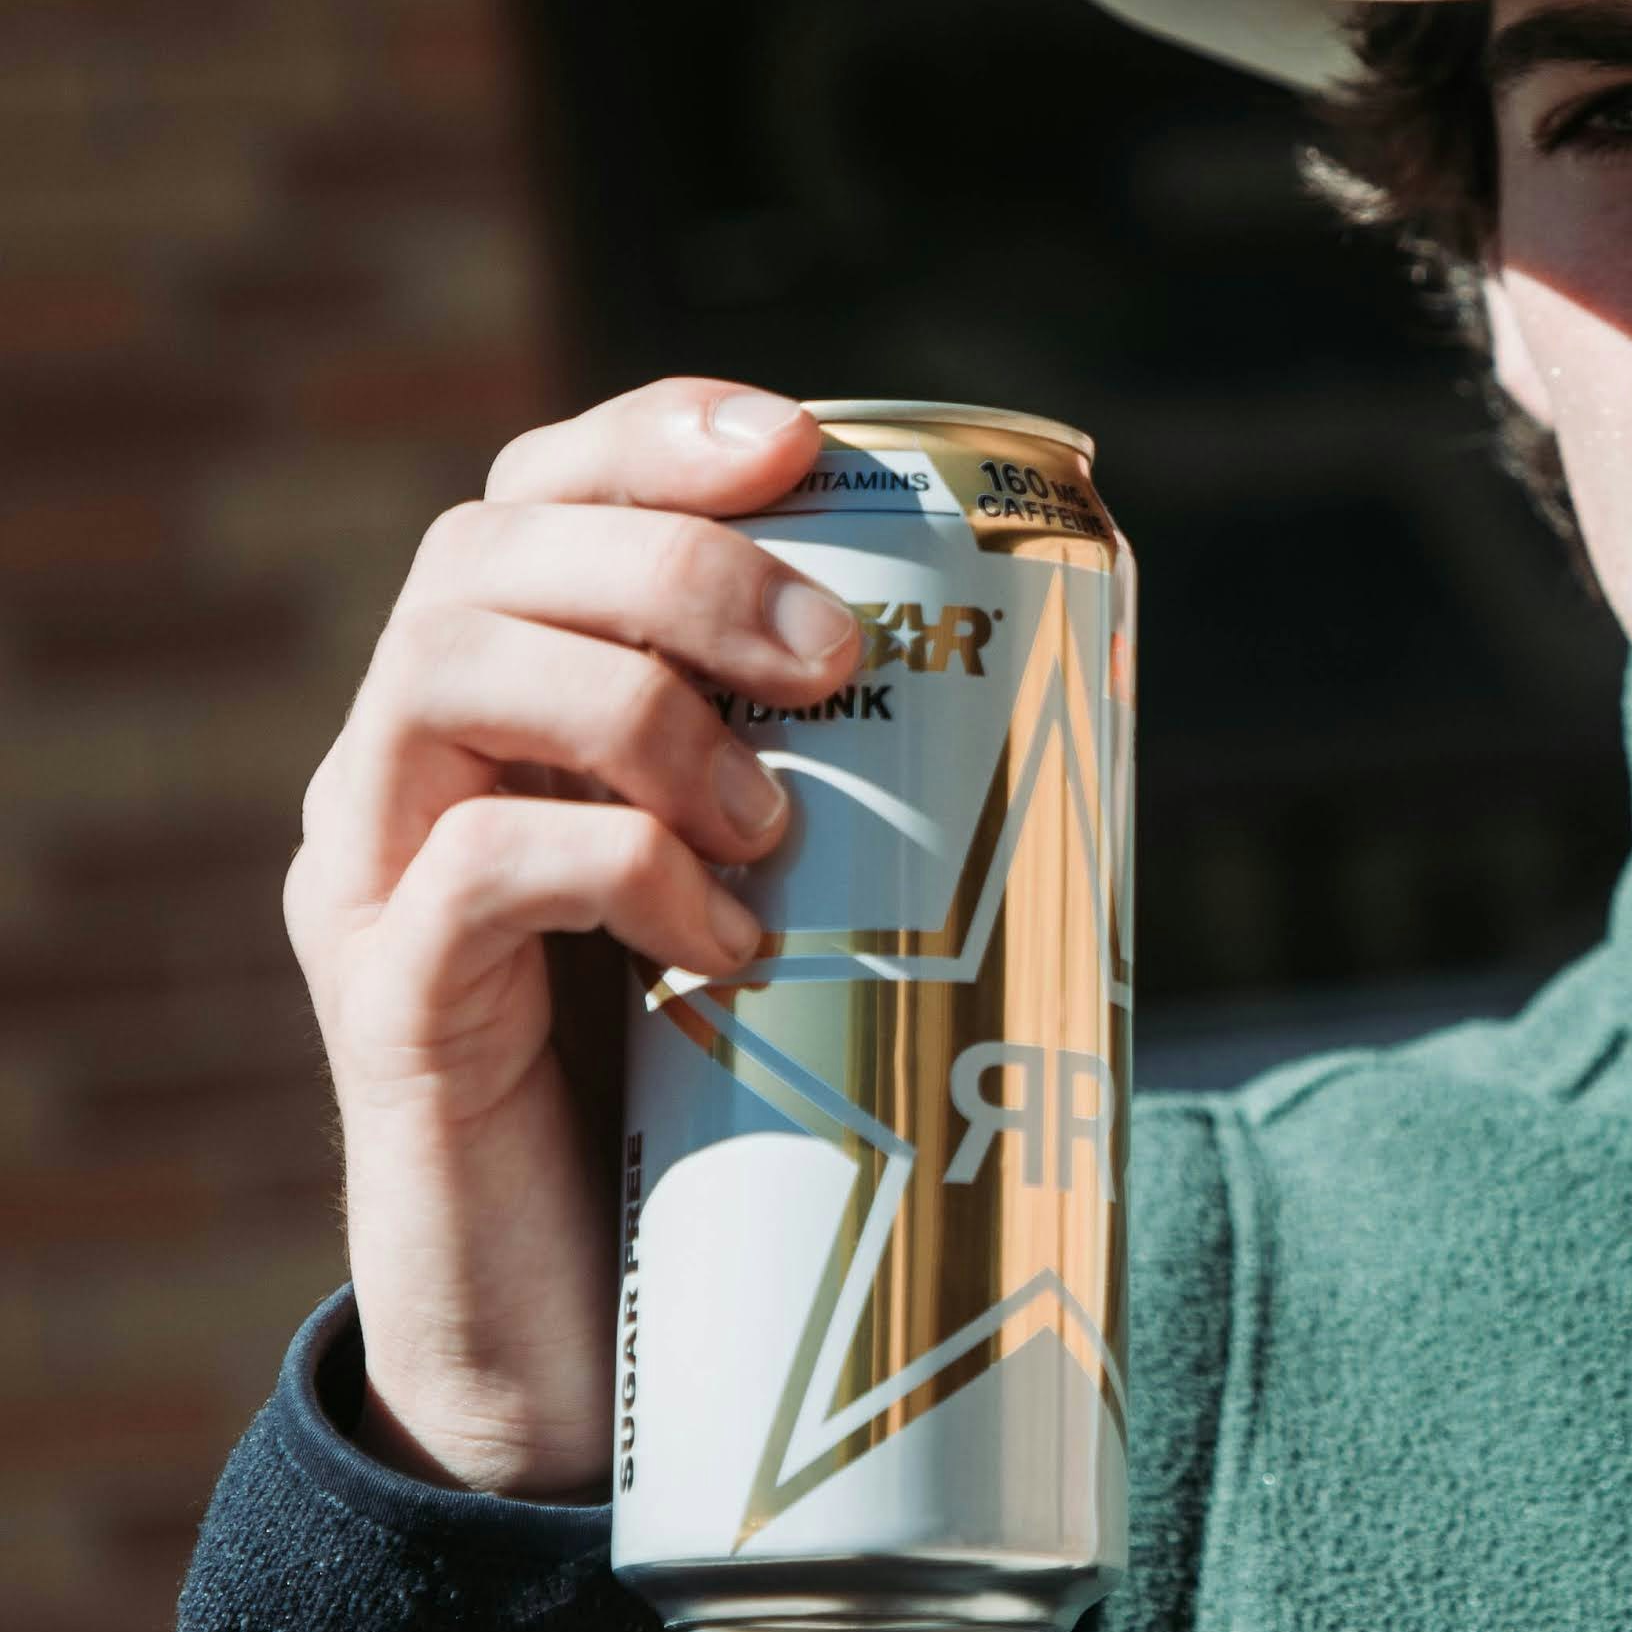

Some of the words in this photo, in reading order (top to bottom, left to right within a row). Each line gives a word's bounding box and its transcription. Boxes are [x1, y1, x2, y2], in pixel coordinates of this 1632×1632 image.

[979, 461, 1049, 499] 160
[624, 1132, 643, 1276] FREE
[619, 1288, 639, 1496] SUGAR
